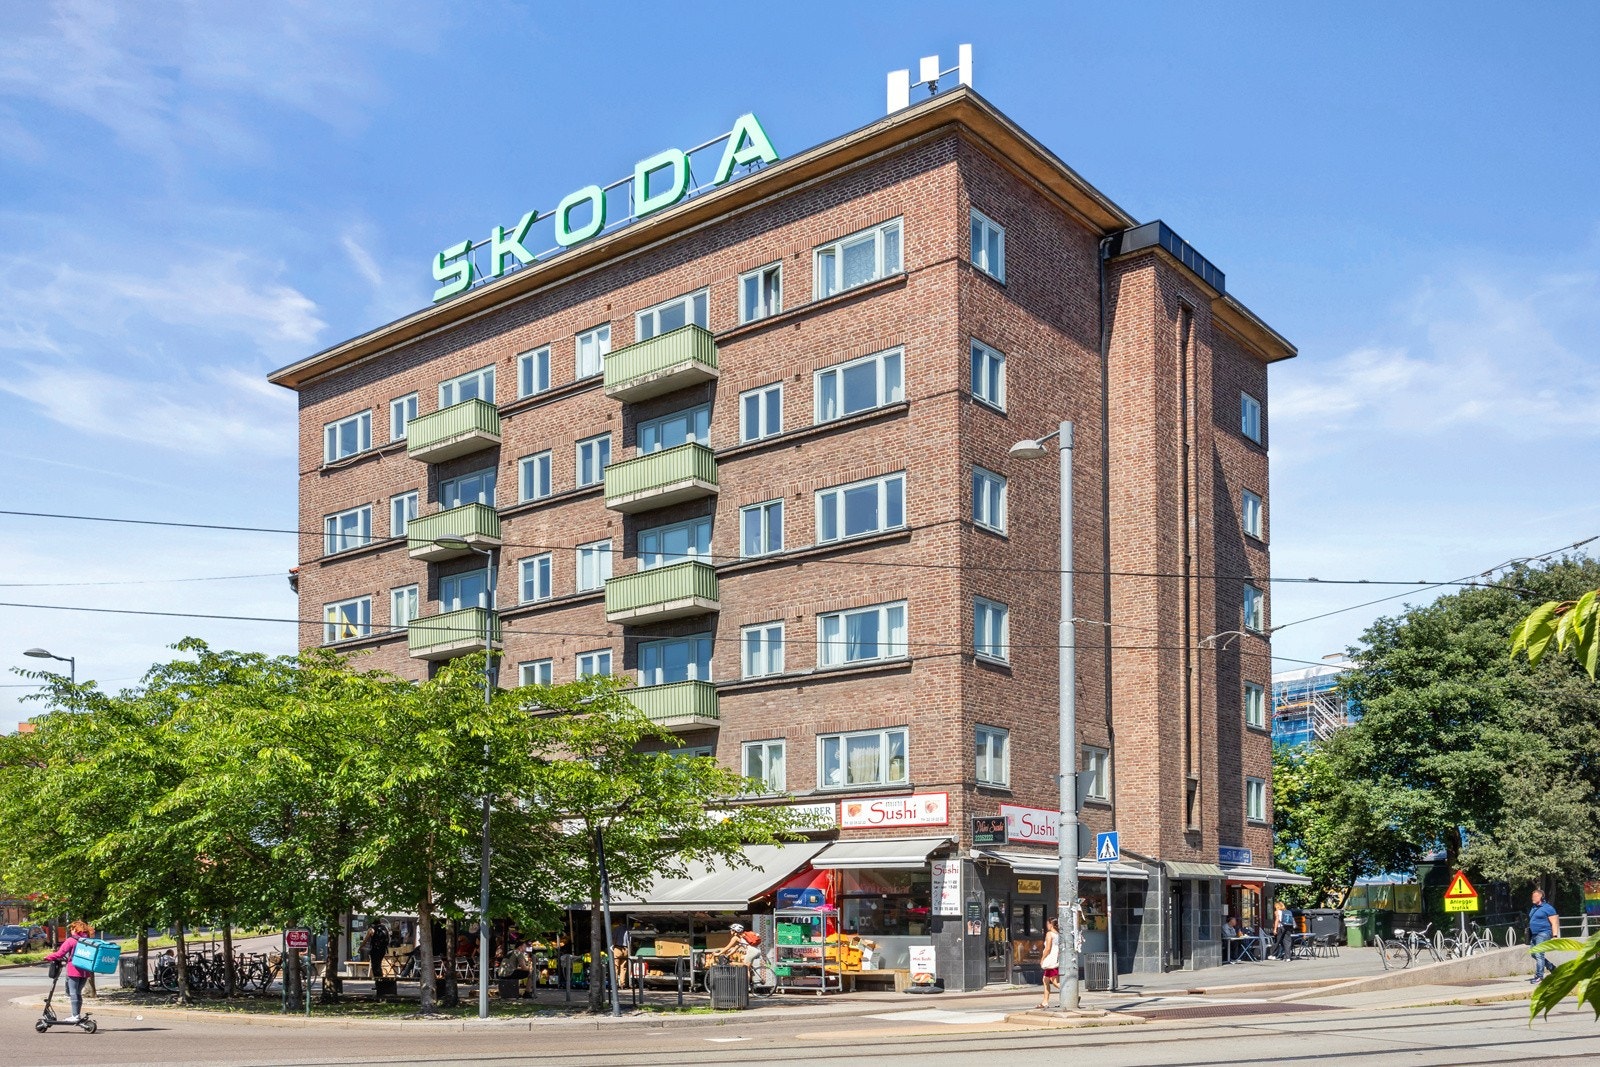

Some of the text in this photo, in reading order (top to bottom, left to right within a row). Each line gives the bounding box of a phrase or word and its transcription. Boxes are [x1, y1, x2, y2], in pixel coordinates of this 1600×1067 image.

[432, 112, 780, 303] SKODA
[868, 800, 917, 824] Sushi
[1020, 813, 1055, 838] Sushi
[932, 863, 959, 876] Sushi
